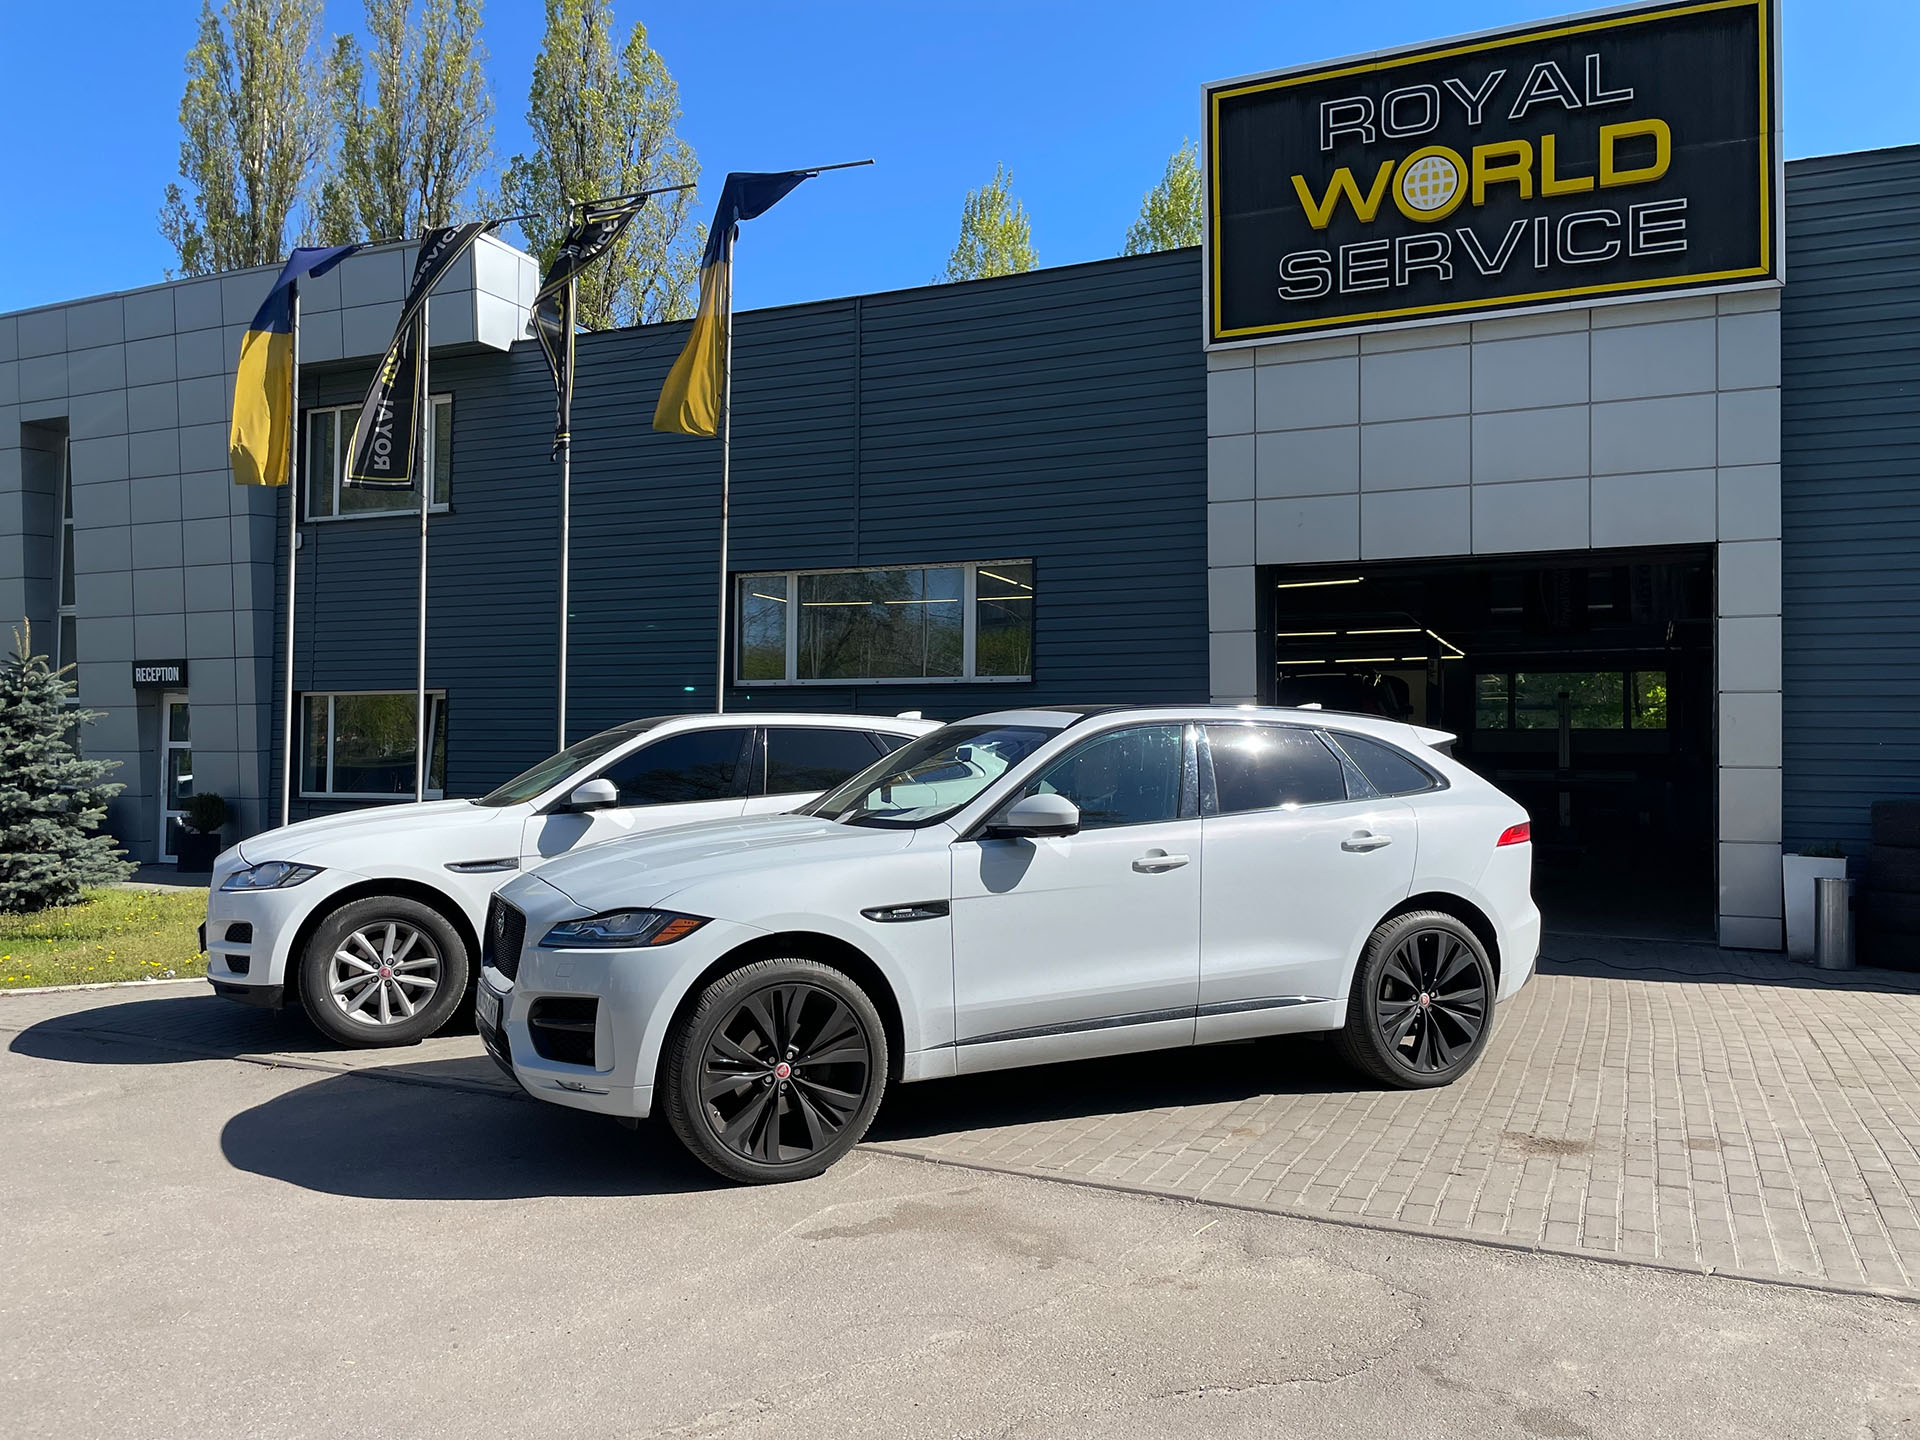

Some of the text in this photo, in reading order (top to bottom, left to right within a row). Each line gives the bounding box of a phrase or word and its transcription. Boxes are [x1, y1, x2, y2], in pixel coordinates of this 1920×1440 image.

[1319, 53, 1635, 152] ROYAL
[1290, 118, 1672, 231] WORLD
[410, 223, 469, 292] ERVIC
[1277, 197, 1689, 301] SERVICE
[135, 666, 180, 682] RECEPTION
